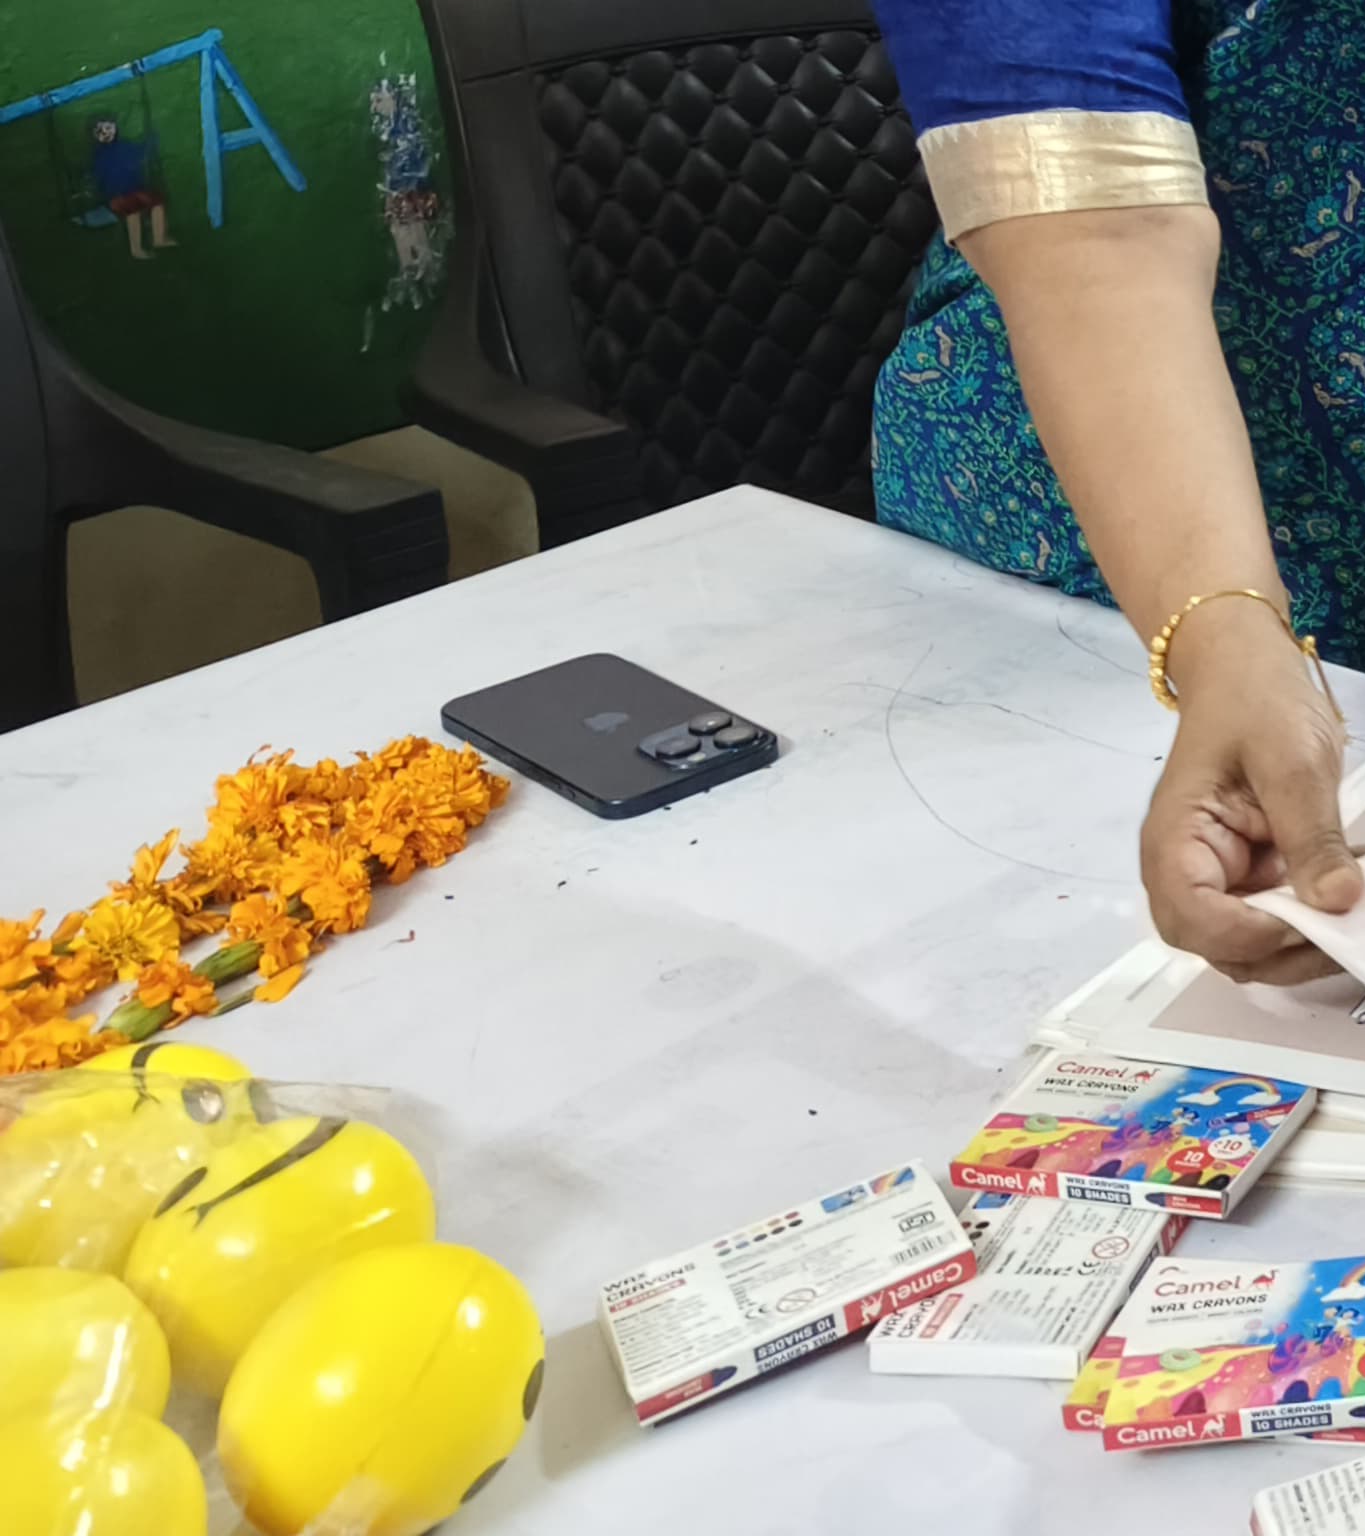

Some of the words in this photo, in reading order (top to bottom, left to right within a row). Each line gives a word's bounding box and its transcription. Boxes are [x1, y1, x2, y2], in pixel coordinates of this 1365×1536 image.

[1056, 1061, 1127, 1079] Camel
[961, 1166, 1023, 1191] Camel
[888, 1263, 962, 1306] Camel
[1155, 1275, 1241, 1298] Camel
[1151, 1301, 1189, 1315] WAX
[1192, 1293, 1268, 1311] CRAYONS
[1117, 1421, 1196, 1445] Camel
[1255, 1419, 1270, 1431] 10
[1273, 1415, 1329, 1430] SHADES
